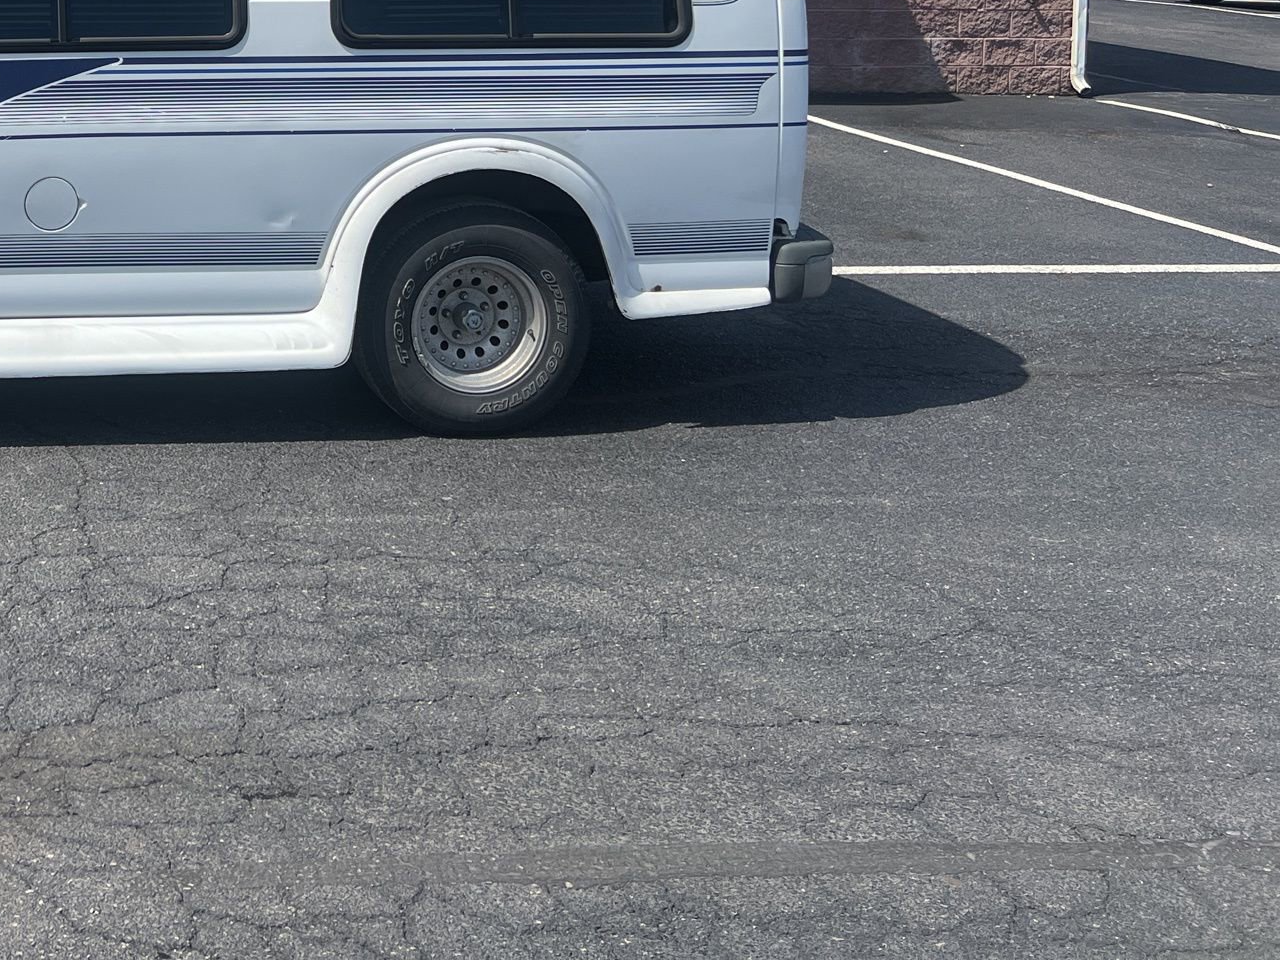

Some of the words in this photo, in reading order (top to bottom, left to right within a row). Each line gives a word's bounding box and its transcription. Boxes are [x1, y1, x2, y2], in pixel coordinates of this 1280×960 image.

[393, 278, 415, 365] TOYO
[540, 269, 568, 334] OPEN
[476, 341, 564, 414] COUNTRY
